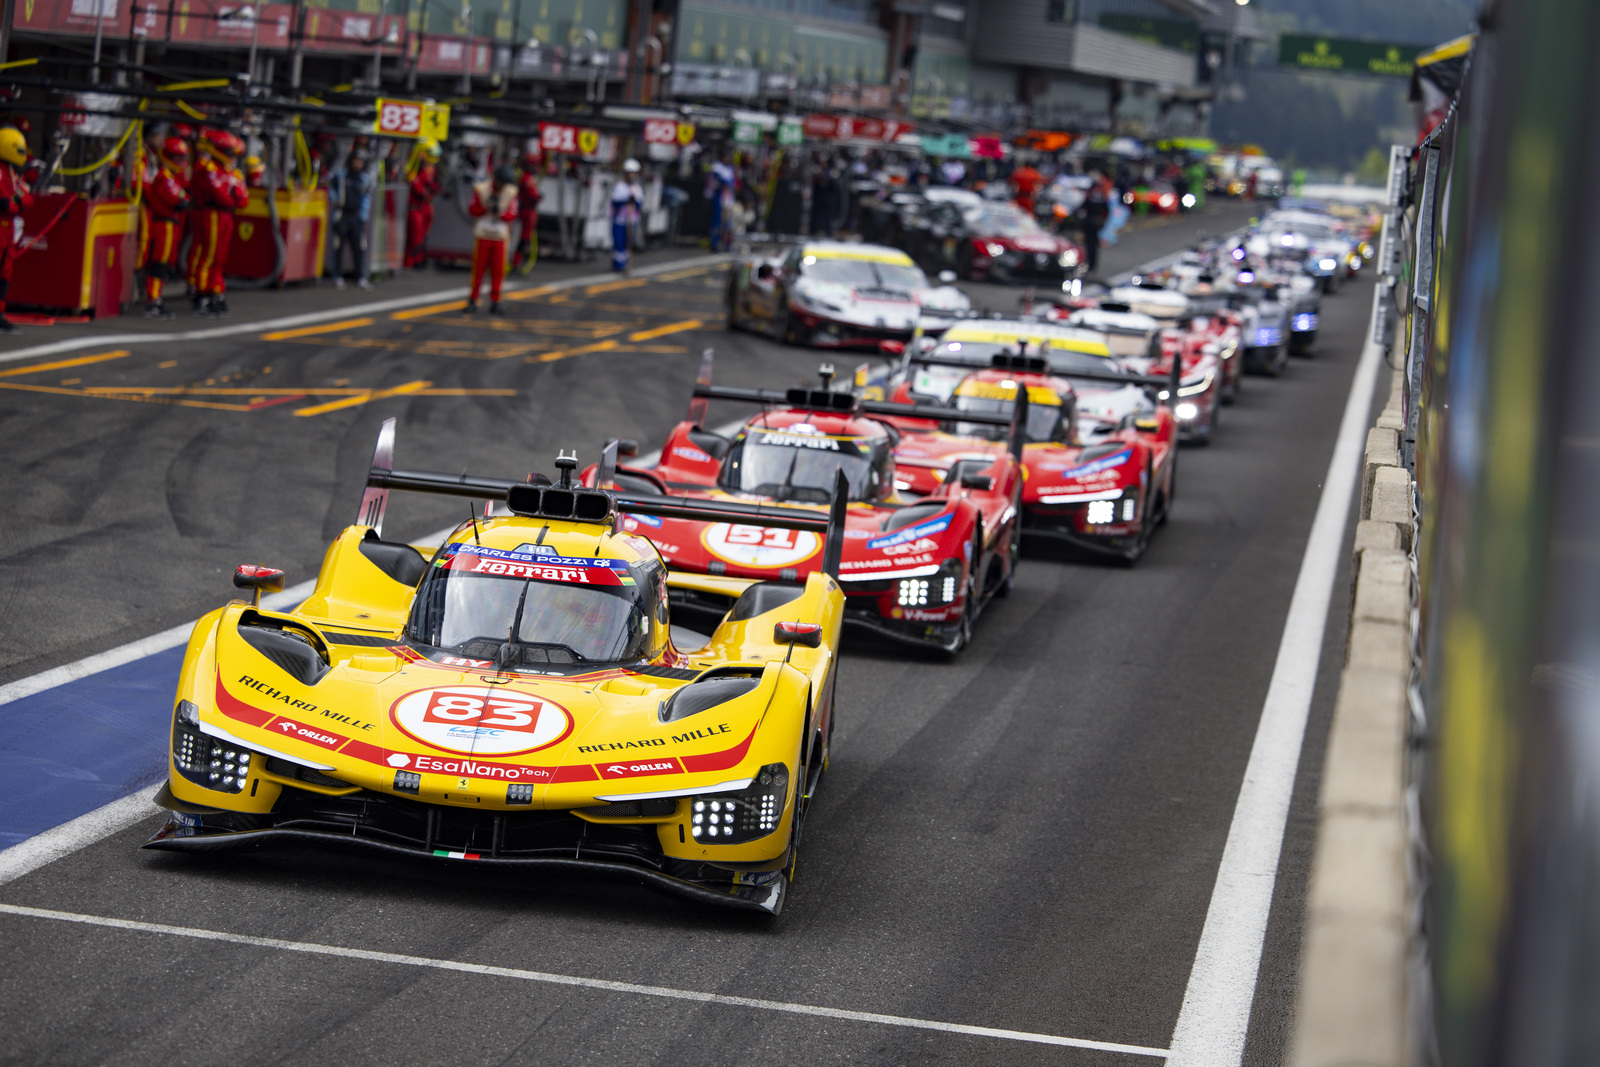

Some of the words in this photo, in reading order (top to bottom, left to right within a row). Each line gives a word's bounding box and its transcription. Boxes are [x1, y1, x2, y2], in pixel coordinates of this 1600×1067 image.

[381, 104, 421, 133] 83
[541, 124, 577, 151] 51
[760, 433, 840, 450] Ferrari
[727, 524, 793, 549] 51
[459, 545, 532, 561] CHARLES
[537, 557, 587, 566] POZZI
[894, 553, 933, 566] MILLE
[471, 557, 590, 583] Ferrari
[442, 656, 489, 668] HY
[238, 675, 318, 712] RICHARD
[320, 709, 376, 732] MILLE
[431, 696, 534, 727] 83
[297, 728, 338, 745] ORLEN
[578, 738, 666, 753] RICHARD
[671, 723, 732, 743] MILLE
[630, 762, 673, 772] ORLEN
